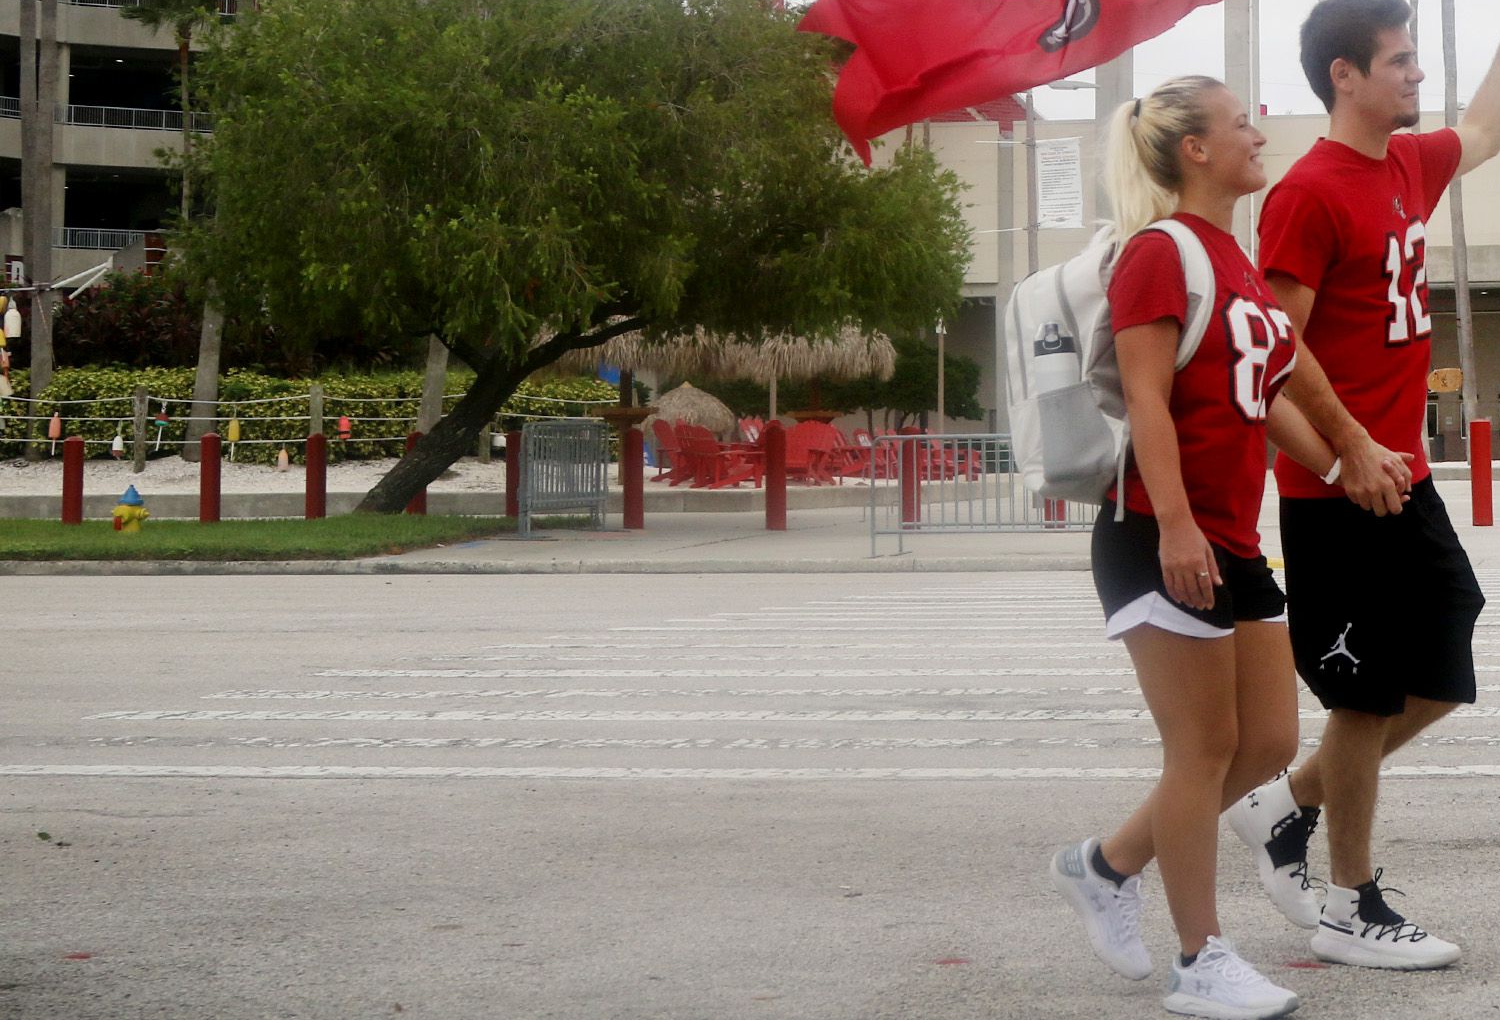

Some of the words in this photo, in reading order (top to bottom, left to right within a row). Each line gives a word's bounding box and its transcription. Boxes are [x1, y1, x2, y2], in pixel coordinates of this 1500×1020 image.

[1382, 219, 1432, 344] 12
[1224, 295, 1298, 420] 87
[1320, 664, 1357, 675] AIR
